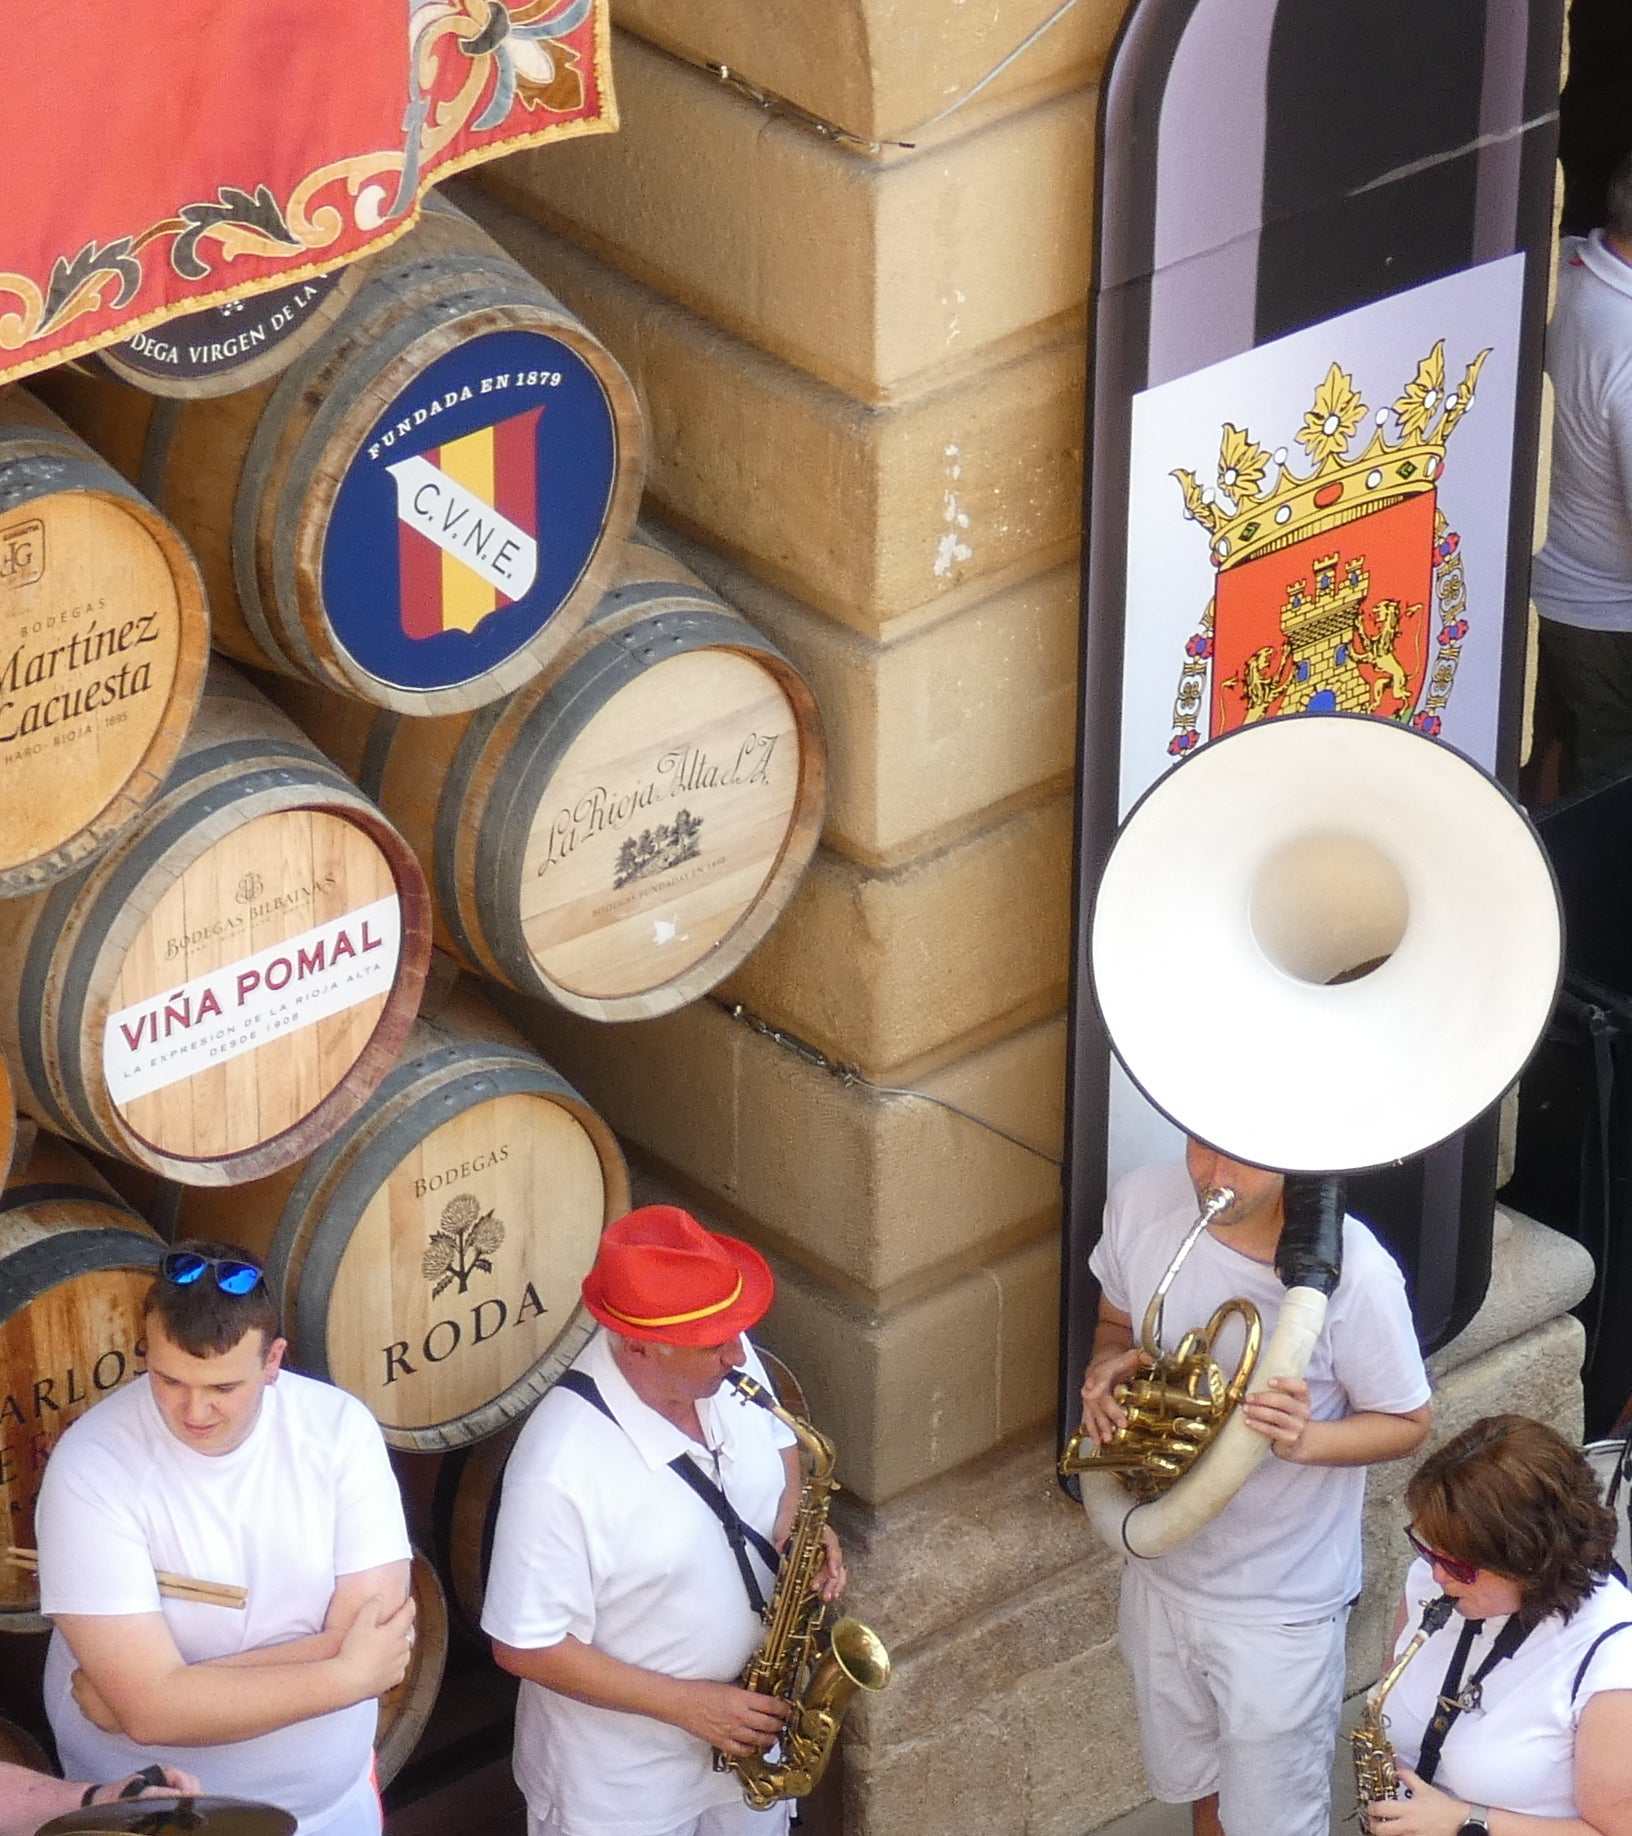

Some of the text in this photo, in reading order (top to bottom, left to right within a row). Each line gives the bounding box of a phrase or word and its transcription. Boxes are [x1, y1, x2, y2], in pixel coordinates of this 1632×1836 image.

[124, 284, 318, 364] DEGA VIRGEN DE LA
[368, 371, 562, 460] FUNDADA EN 1879
[20, 597, 106, 638] BODEGAS
[4, 742, 42, 765] HARO
[53, 724, 92, 749] RIOJA
[537, 808, 579, 878] La
[573, 785, 655, 830] Rioja
[164, 913, 244, 961] BODEGAS
[119, 988, 223, 1052] VIÑA
[236, 920, 384, 1007] POMAL
[123, 1064, 142, 1079] LA
[243, 1013, 262, 1027] DE
[269, 1002, 287, 1017] LA
[295, 982, 339, 1006] RIOJA
[346, 962, 382, 984] ALTA
[209, 1012, 300, 1057] DESDE 1908
[413, 1144, 510, 1198] BODEGAS
[380, 1281, 549, 1387] RODA
